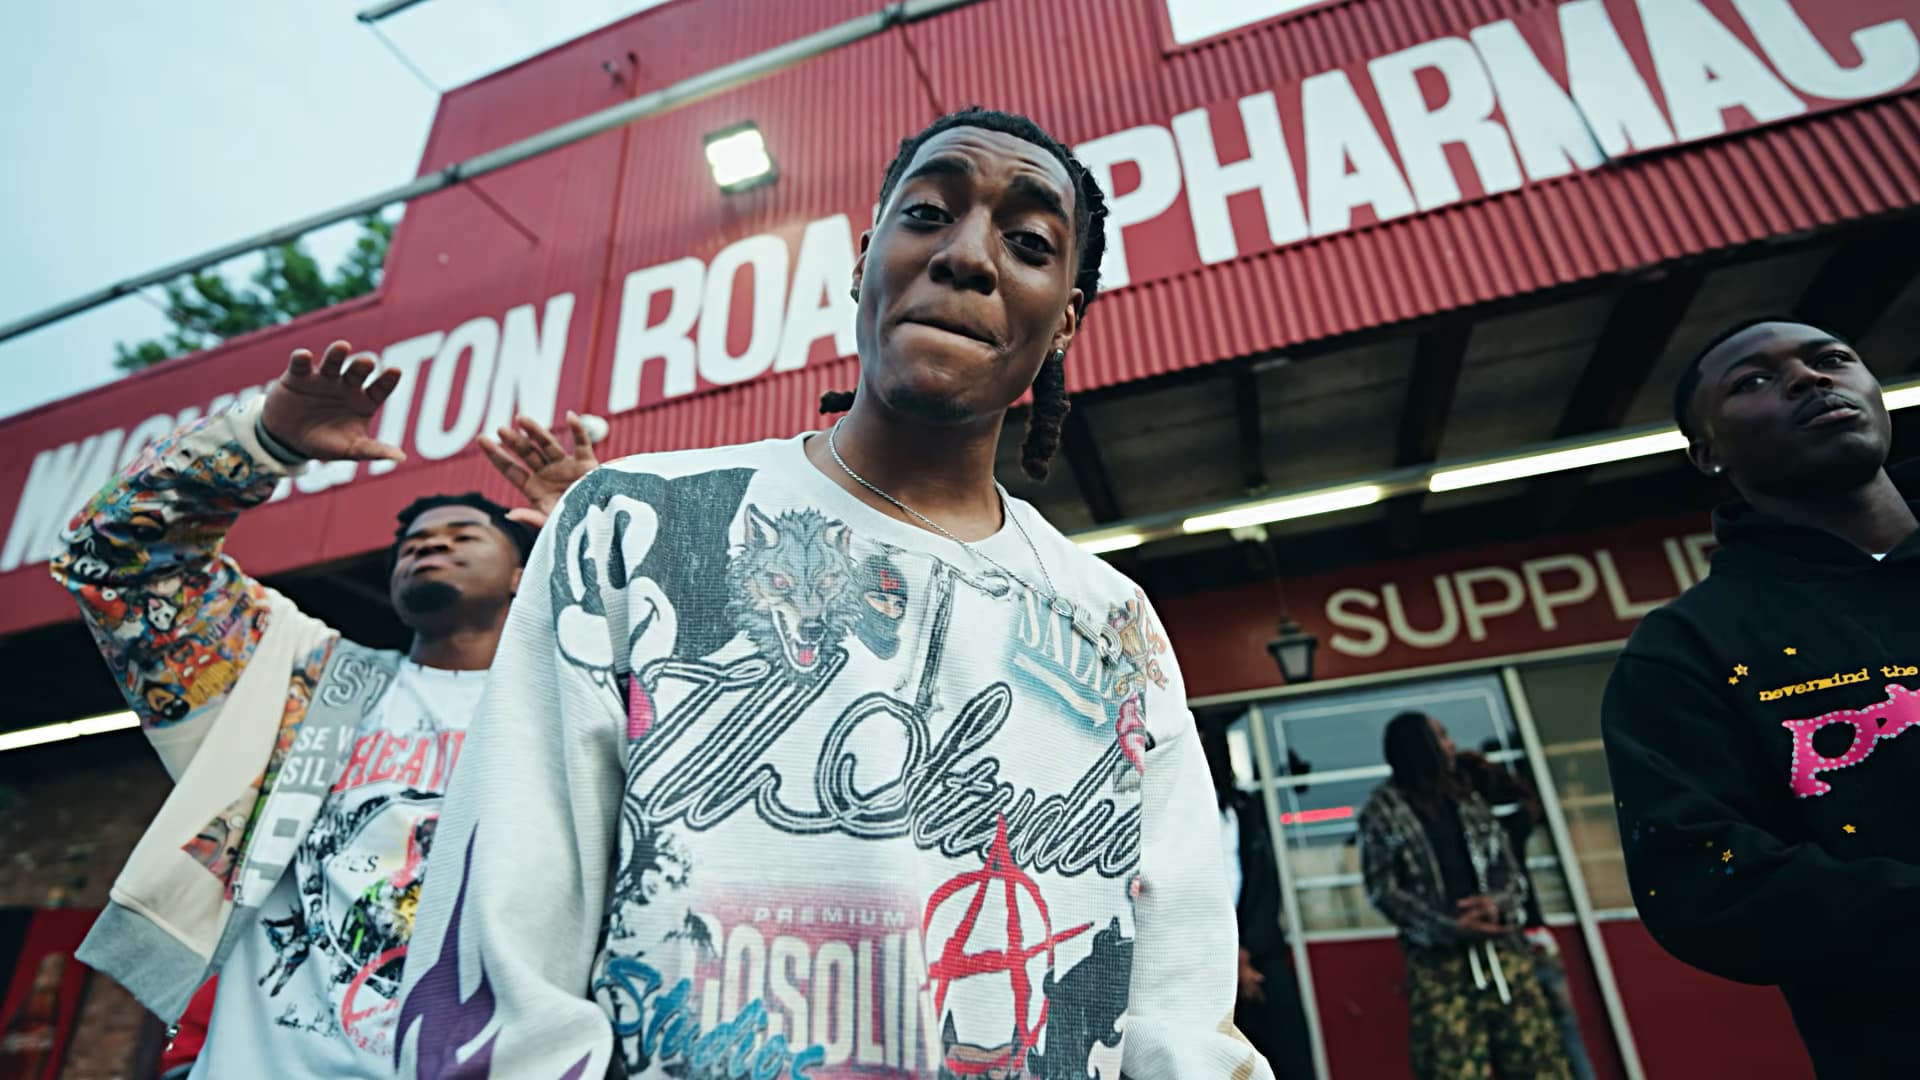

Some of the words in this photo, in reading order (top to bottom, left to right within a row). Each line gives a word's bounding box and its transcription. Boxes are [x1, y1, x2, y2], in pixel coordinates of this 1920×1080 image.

[607, 203, 881, 414] ROA
[1759, 668, 1871, 701] nevermind
[1880, 665, 1919, 678] the
[753, 906, 906, 926] PREMIUM
